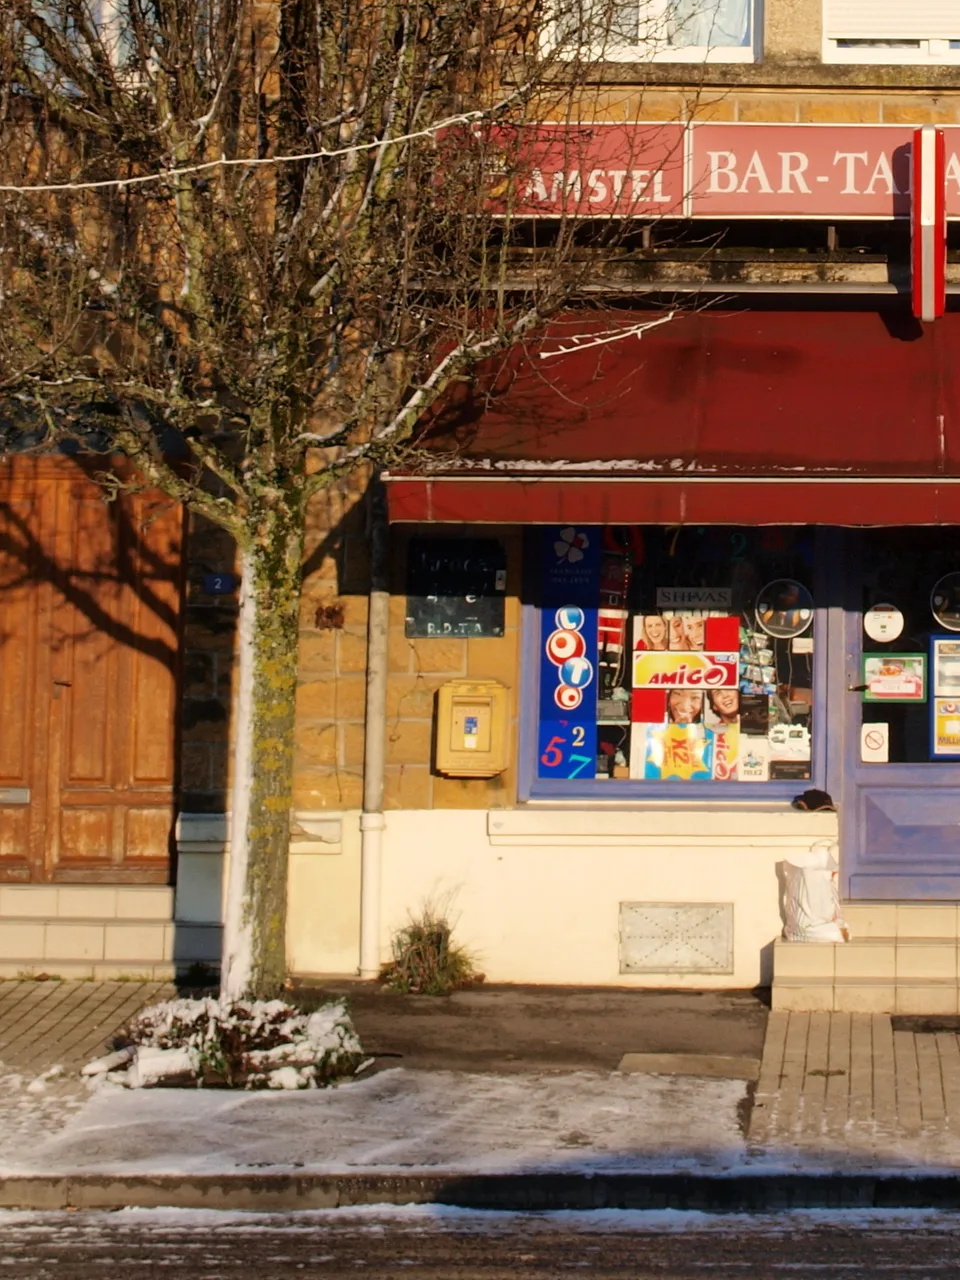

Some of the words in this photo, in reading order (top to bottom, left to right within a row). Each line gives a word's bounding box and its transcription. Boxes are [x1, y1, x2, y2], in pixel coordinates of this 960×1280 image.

[522, 167, 671, 203] AMSTEL
[214, 578, 223, 590] 2
[572, 726, 585, 747] 2
[541, 736, 567, 767] 5
[567, 754, 592, 779] 7
